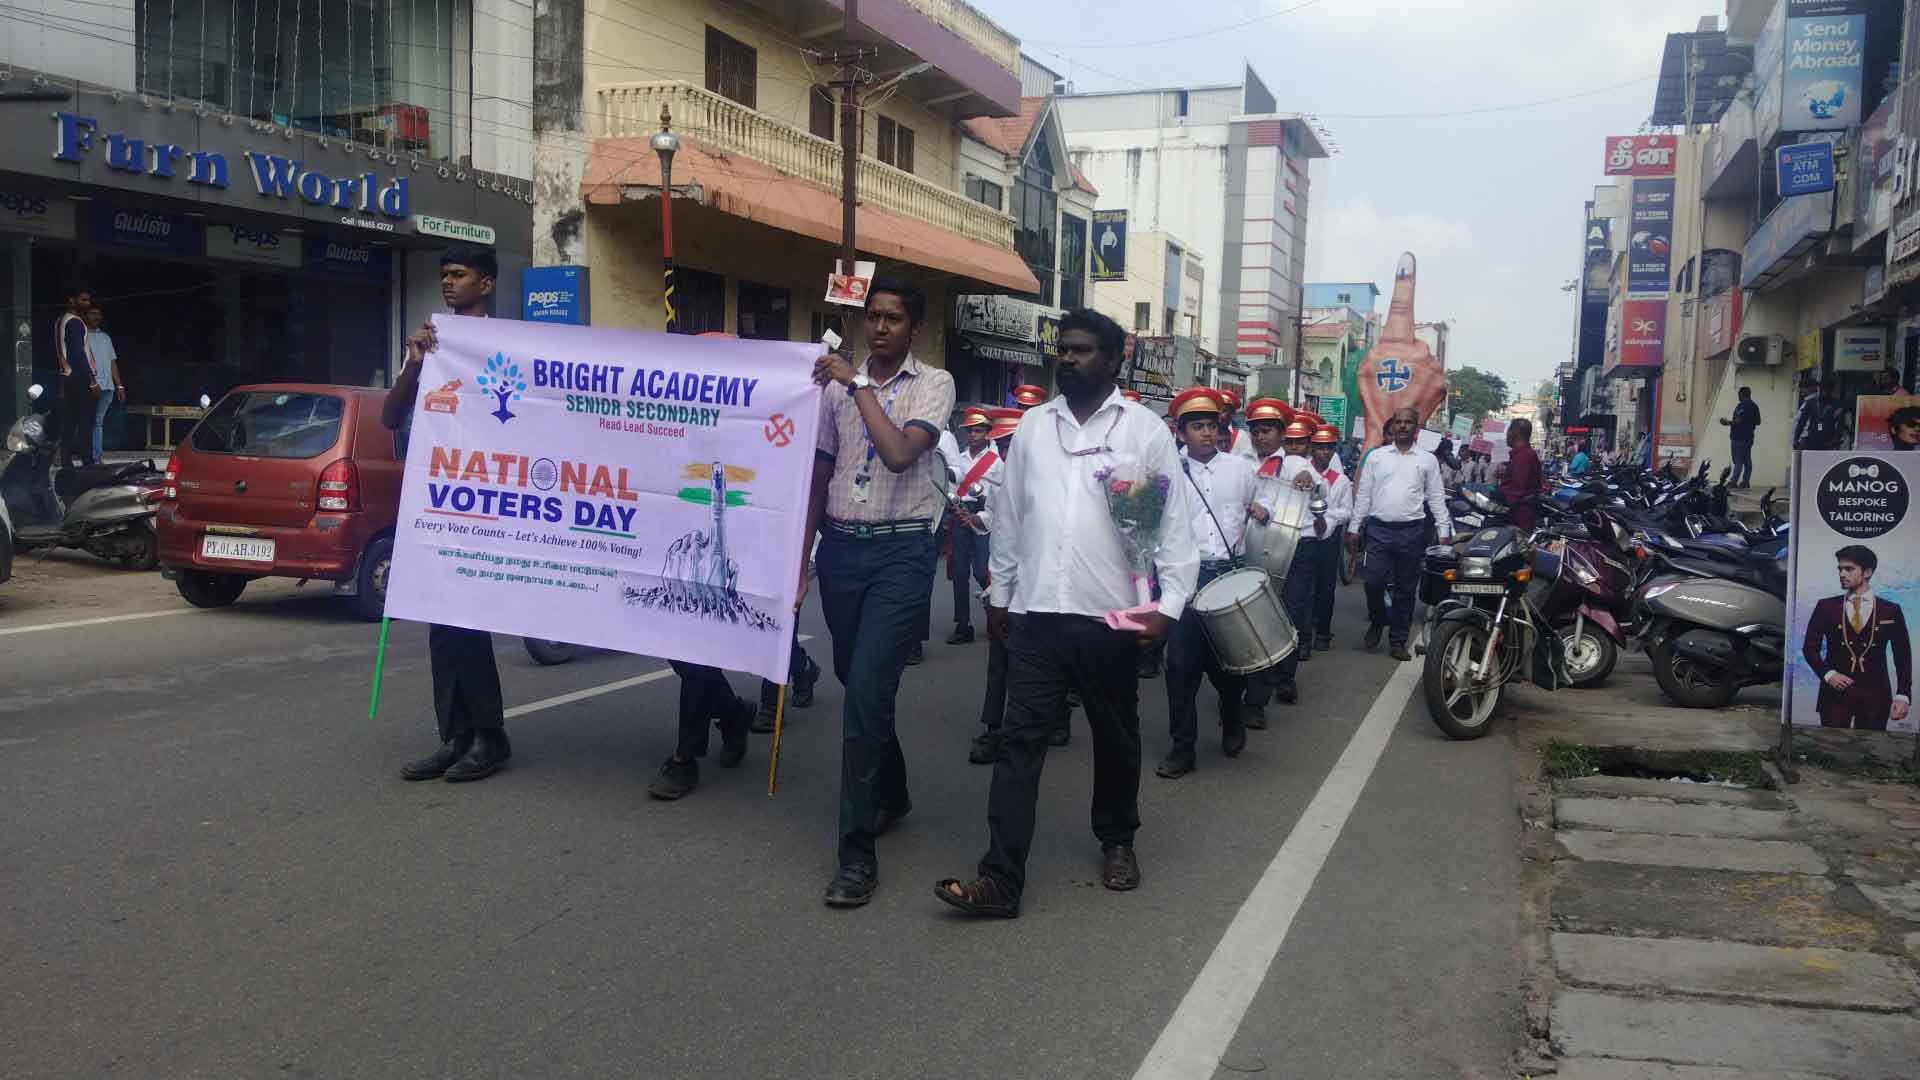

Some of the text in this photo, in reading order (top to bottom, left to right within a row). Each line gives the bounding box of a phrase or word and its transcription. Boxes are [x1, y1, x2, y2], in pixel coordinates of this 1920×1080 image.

[1803, 21, 1848, 36] Send
[1792, 39, 1857, 55] Money
[1790, 52, 1861, 70] Abroad
[51, 111, 409, 217] Furn World
[1606, 138, 1674, 173] தீன்
[1792, 160, 1819, 172] ATM
[422, 217, 491, 240] For Furniture
[528, 291, 559, 308] peps
[533, 359, 759, 407] BRIGHT ACADEMY
[566, 394, 721, 427] SENIOR SECONDARY
[599, 418, 685, 438] Read Lead Succeed
[1829, 481, 1899, 493] MANOG
[427, 483, 637, 532] VOTERS DAY
[1838, 497, 1888, 507] BESPOKE
[1829, 511, 1895, 522] TAILORING
[414, 518, 446, 533] Every
[448, 522, 470, 534] Vote
[471, 524, 505, 540] Counts
[540, 533, 577, 548] Achieve
[580, 538, 607, 553] 100%
[610, 542, 643, 558] Voting!
[206, 541, 272, 557] PY.01.AH.9192
